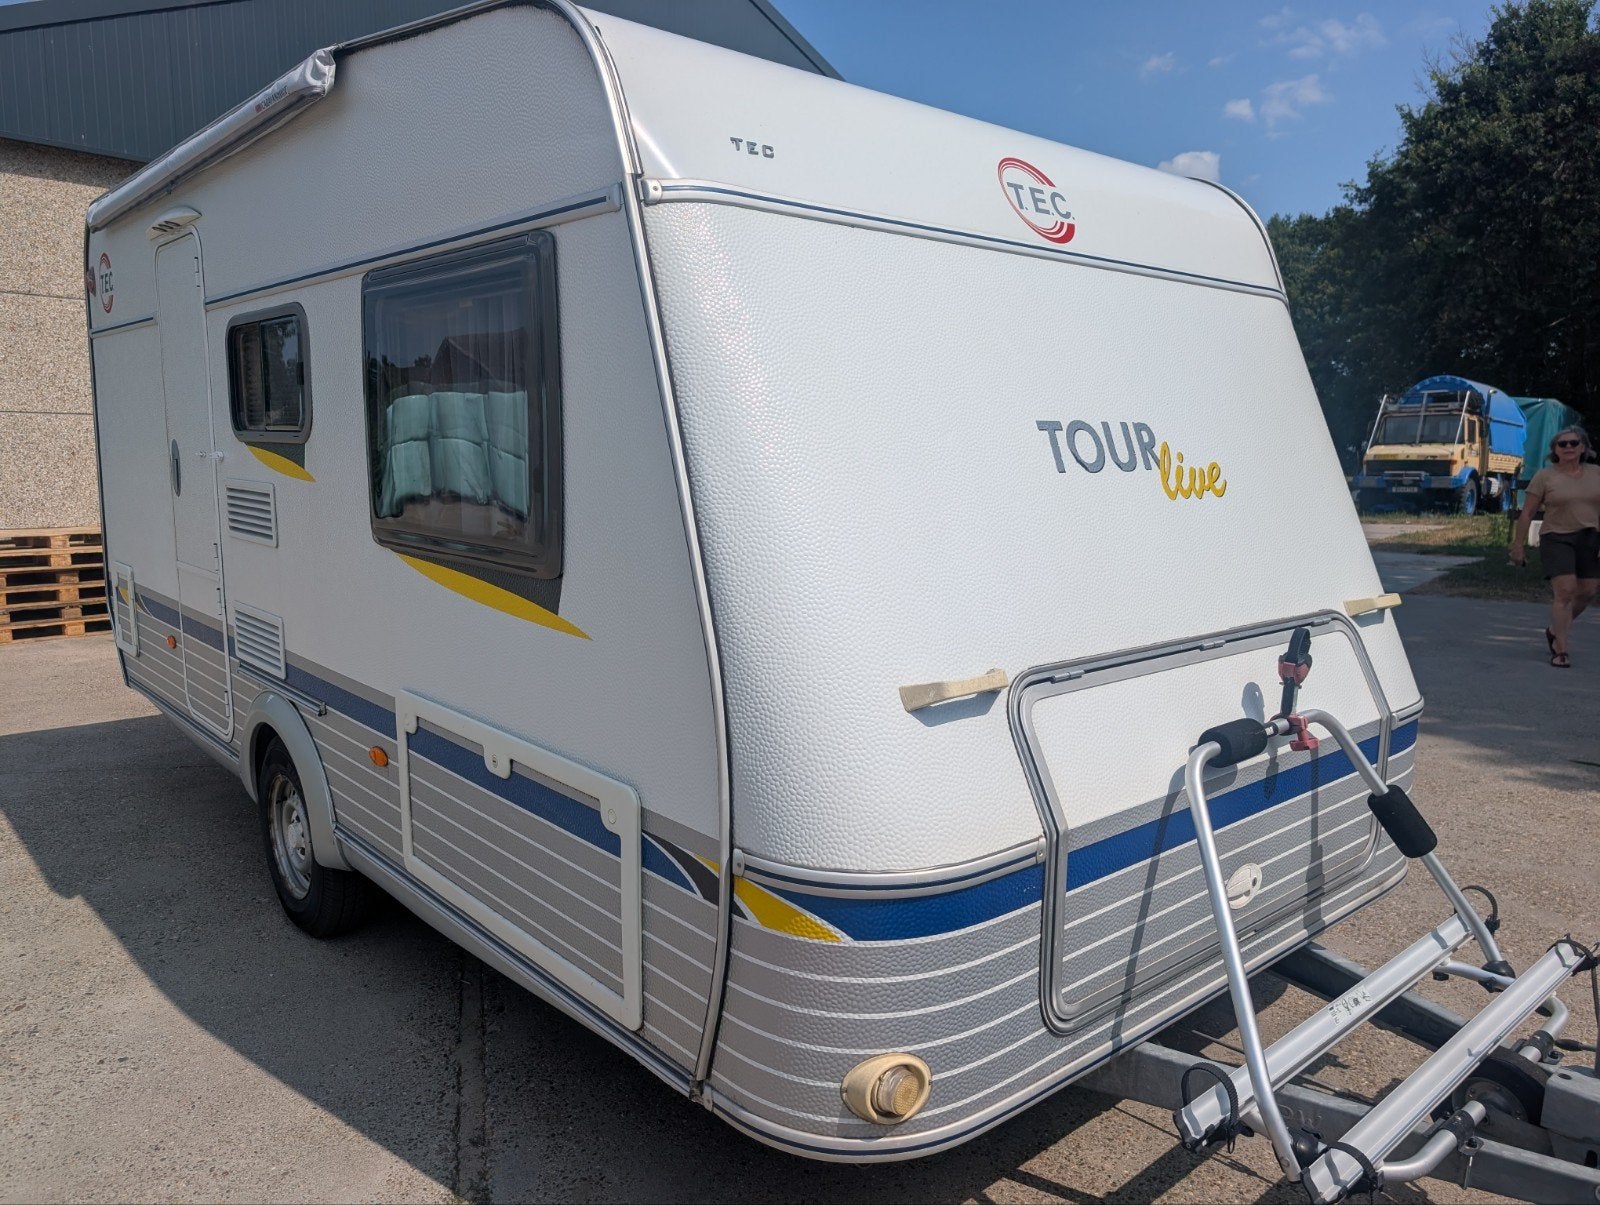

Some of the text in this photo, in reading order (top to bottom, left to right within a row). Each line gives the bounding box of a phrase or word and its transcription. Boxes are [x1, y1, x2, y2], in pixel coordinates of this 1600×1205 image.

[730, 136, 775, 159] TEC
[1036, 419, 1227, 501] TOUR live
